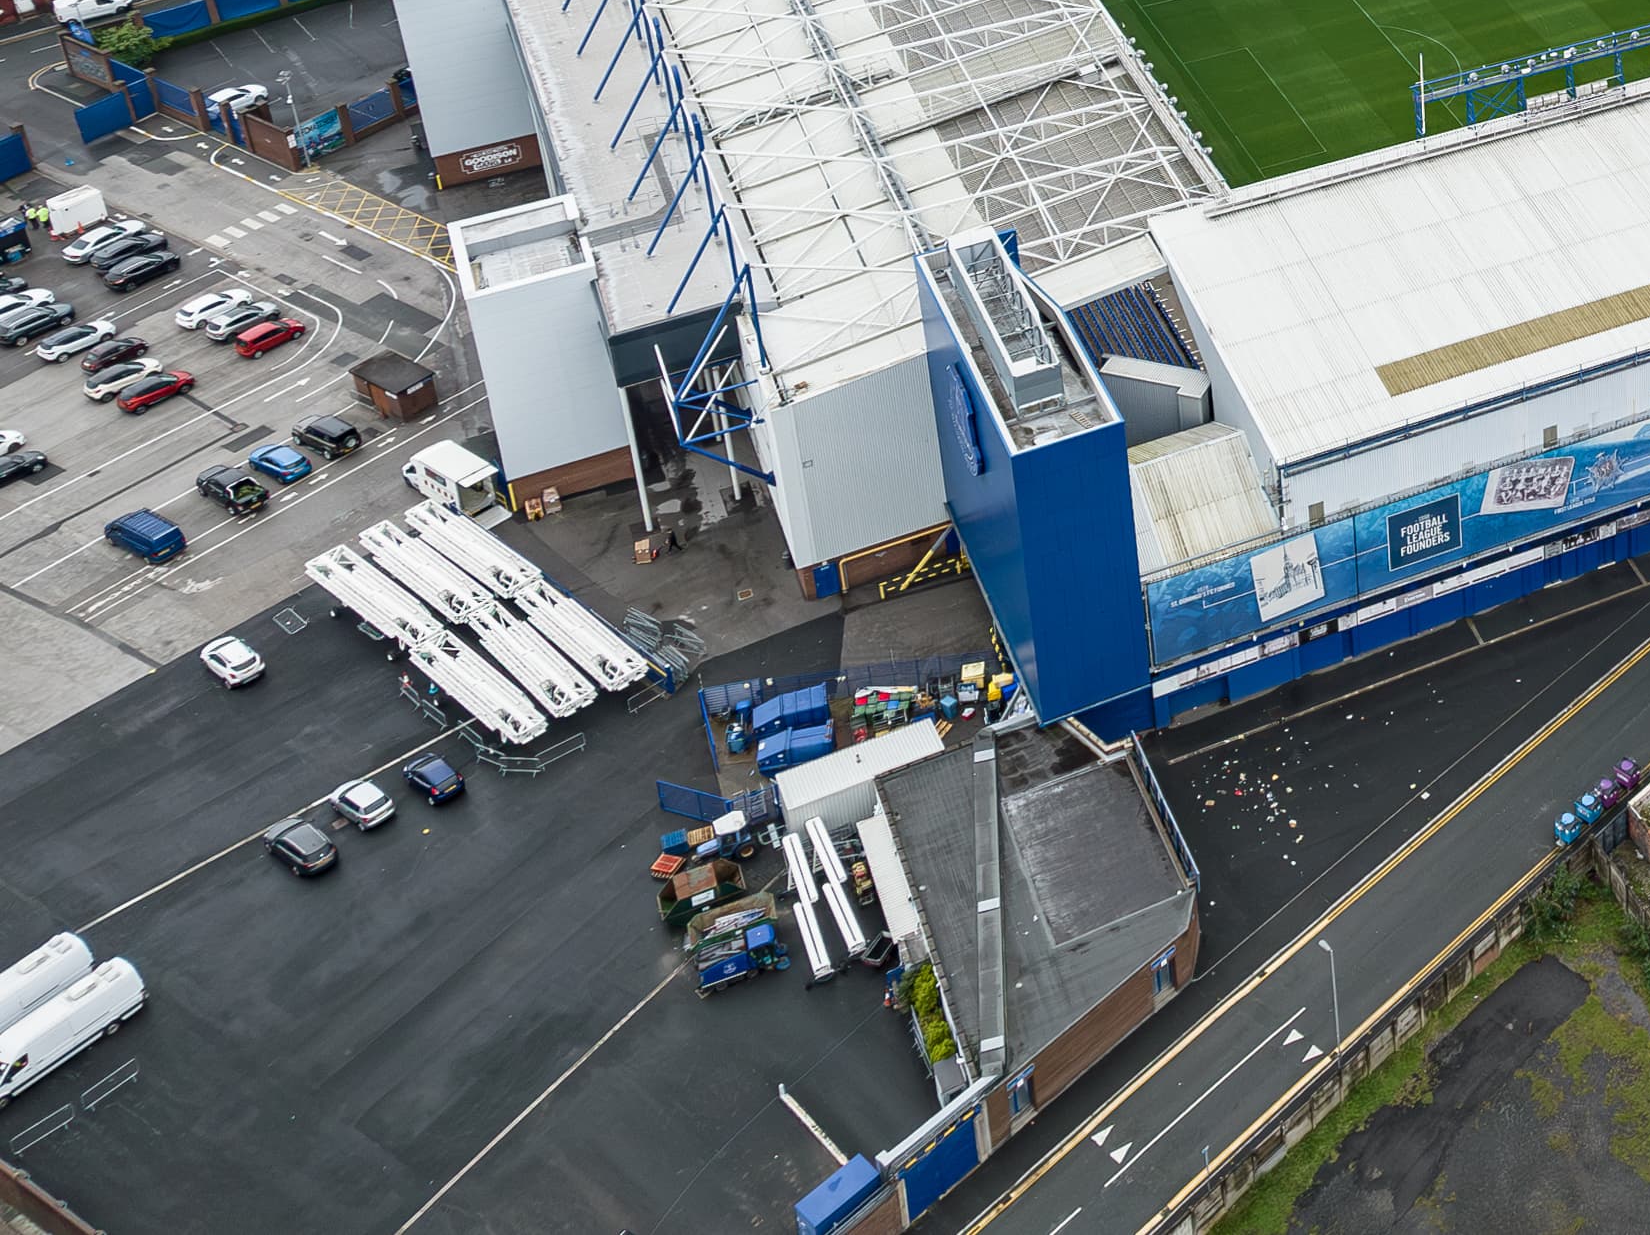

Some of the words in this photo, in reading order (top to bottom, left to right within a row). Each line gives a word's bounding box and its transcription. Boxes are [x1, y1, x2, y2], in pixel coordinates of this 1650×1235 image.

[465, 148, 517, 166] GOODISON
[1400, 513, 1448, 538] FOOTBALL
[1406, 525, 1443, 545] LEAGUE
[1400, 531, 1450, 557] FOUNDERS
